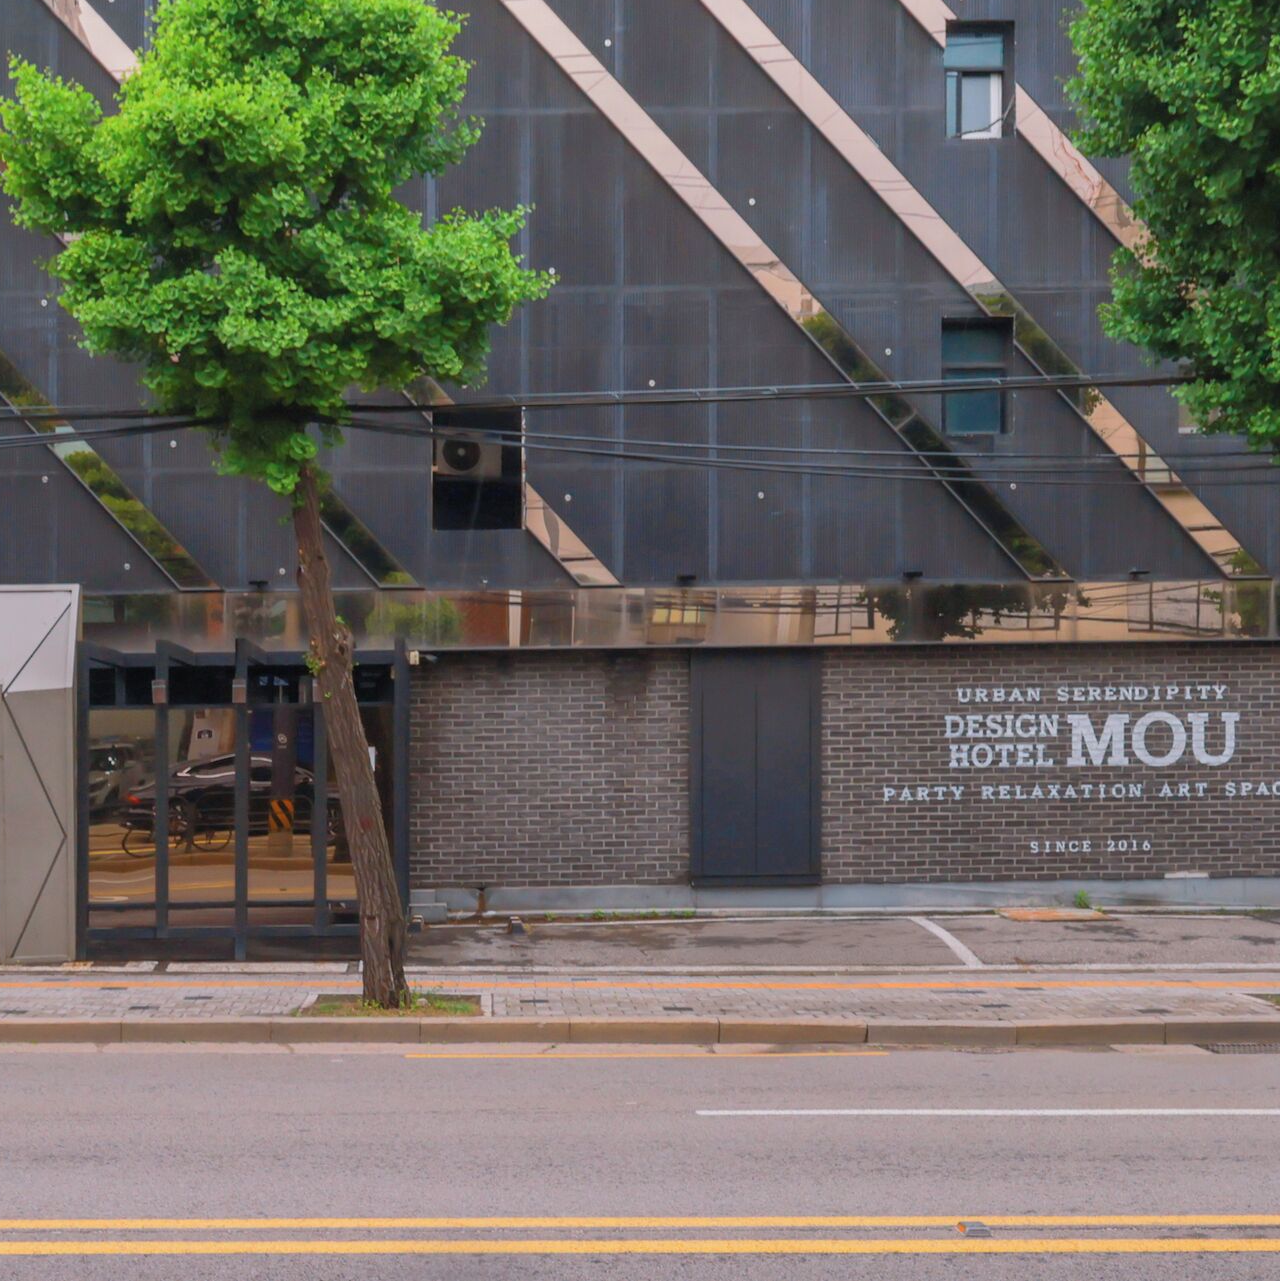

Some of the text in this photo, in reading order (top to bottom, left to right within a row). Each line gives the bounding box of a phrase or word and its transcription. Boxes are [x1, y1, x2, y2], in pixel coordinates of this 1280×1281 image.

[956, 685, 1228, 702] URBAN SERENDIPITY
[944, 714, 1059, 738] DESIGN
[1066, 711, 1240, 767] MOU
[949, 743, 1053, 768] HOTEL
[883, 785, 964, 801] PARTY
[981, 783, 1144, 799] RELAXATION
[1159, 782, 1208, 797] ART
[1030, 840, 1151, 854] SINCE 2016
